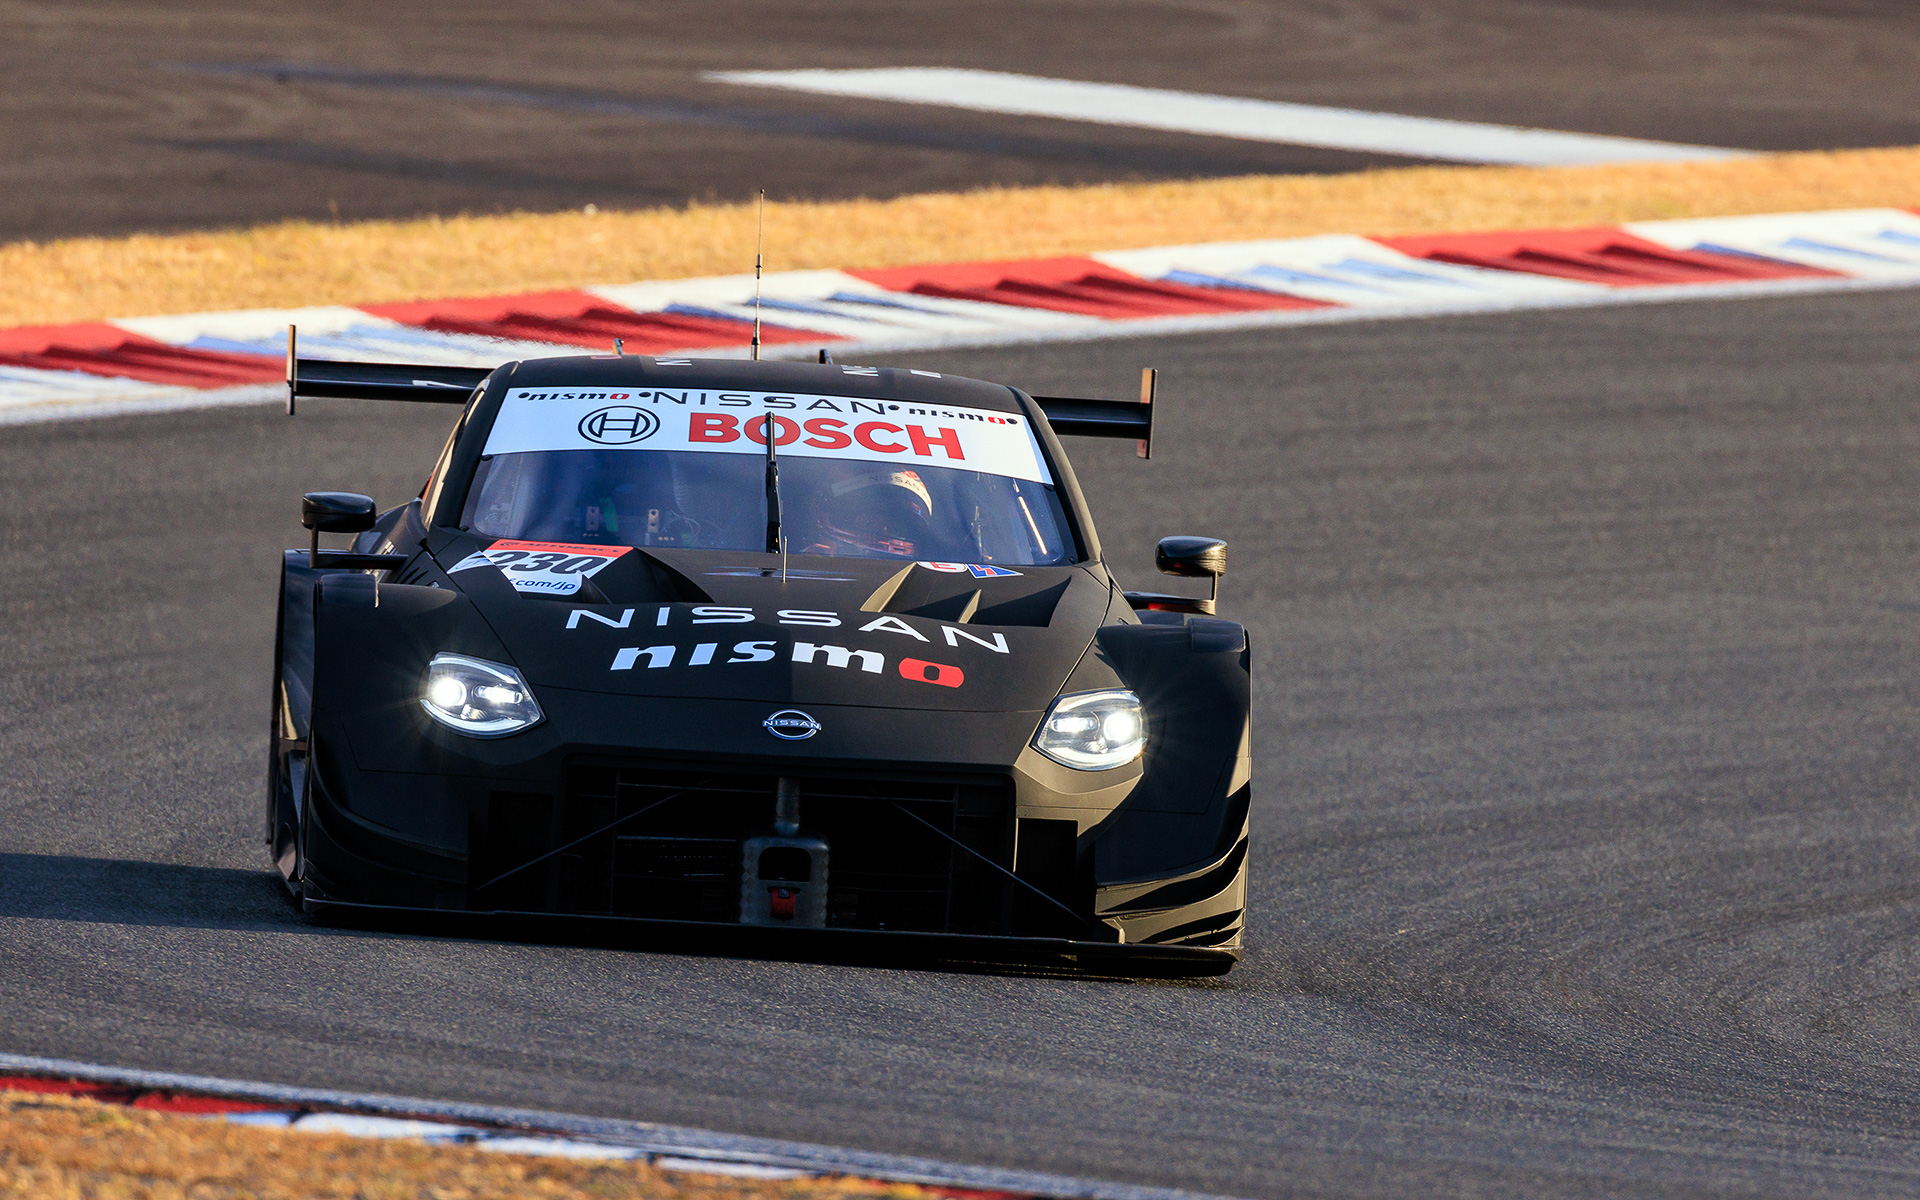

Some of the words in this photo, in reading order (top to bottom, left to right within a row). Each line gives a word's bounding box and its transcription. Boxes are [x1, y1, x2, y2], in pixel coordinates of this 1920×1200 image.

[528, 391, 630, 401] nismo
[652, 391, 886, 416] NISSAN
[908, 407, 1006, 425] nismo
[688, 412, 965, 461] BOSCH
[565, 606, 1010, 654] NISSAN
[609, 640, 965, 688] nismo
[764, 720, 820, 730] NISSAN
